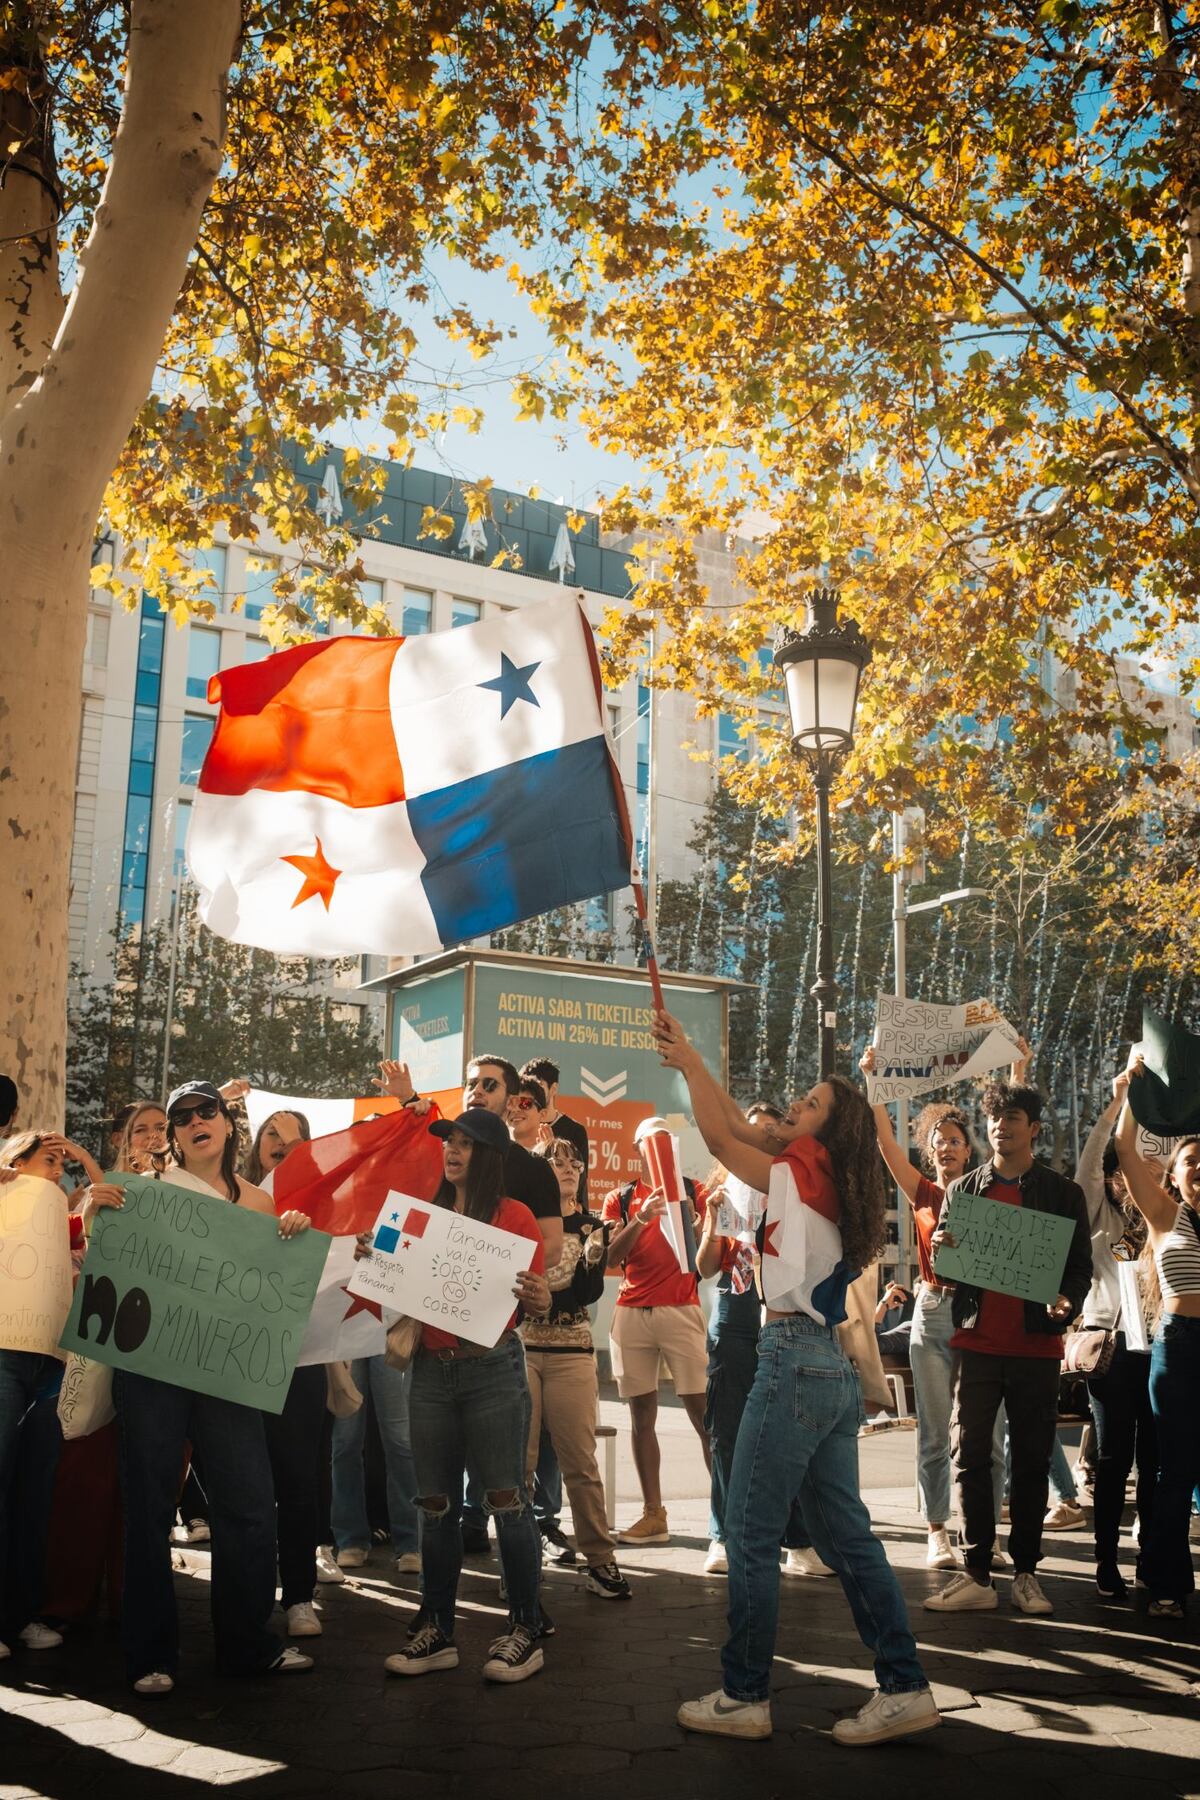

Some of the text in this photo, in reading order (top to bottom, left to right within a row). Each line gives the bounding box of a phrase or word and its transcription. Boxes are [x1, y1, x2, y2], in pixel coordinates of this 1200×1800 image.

[498, 992, 545, 1016] ACTIVA
[549, 998, 582, 1020] SABA
[878, 998, 952, 1030] DESDE
[498, 1017, 545, 1040] ACTIVA
[548, 1022, 566, 1041] UN
[570, 1027, 599, 1045] 25%
[602, 1028, 617, 1047] DE
[872, 1051, 970, 1078] PANAM
[872, 1082, 913, 1103] NO
[586, 1117, 623, 1130] 1r mes
[590, 1179, 615, 1188] totes
[118, 1179, 210, 1239] SOMOS
[954, 1197, 1057, 1242] EL ORO DE
[446, 1216, 516, 1261] Panamá
[99, 1223, 284, 1314] CANALEROS
[446, 1247, 477, 1267] vale
[1030, 1244, 1057, 1272] ES
[439, 1262, 474, 1286] ORO
[956, 1255, 1031, 1293] VERDE
[444, 1283, 465, 1300] NO
[152, 1304, 292, 1388] MINEROS
